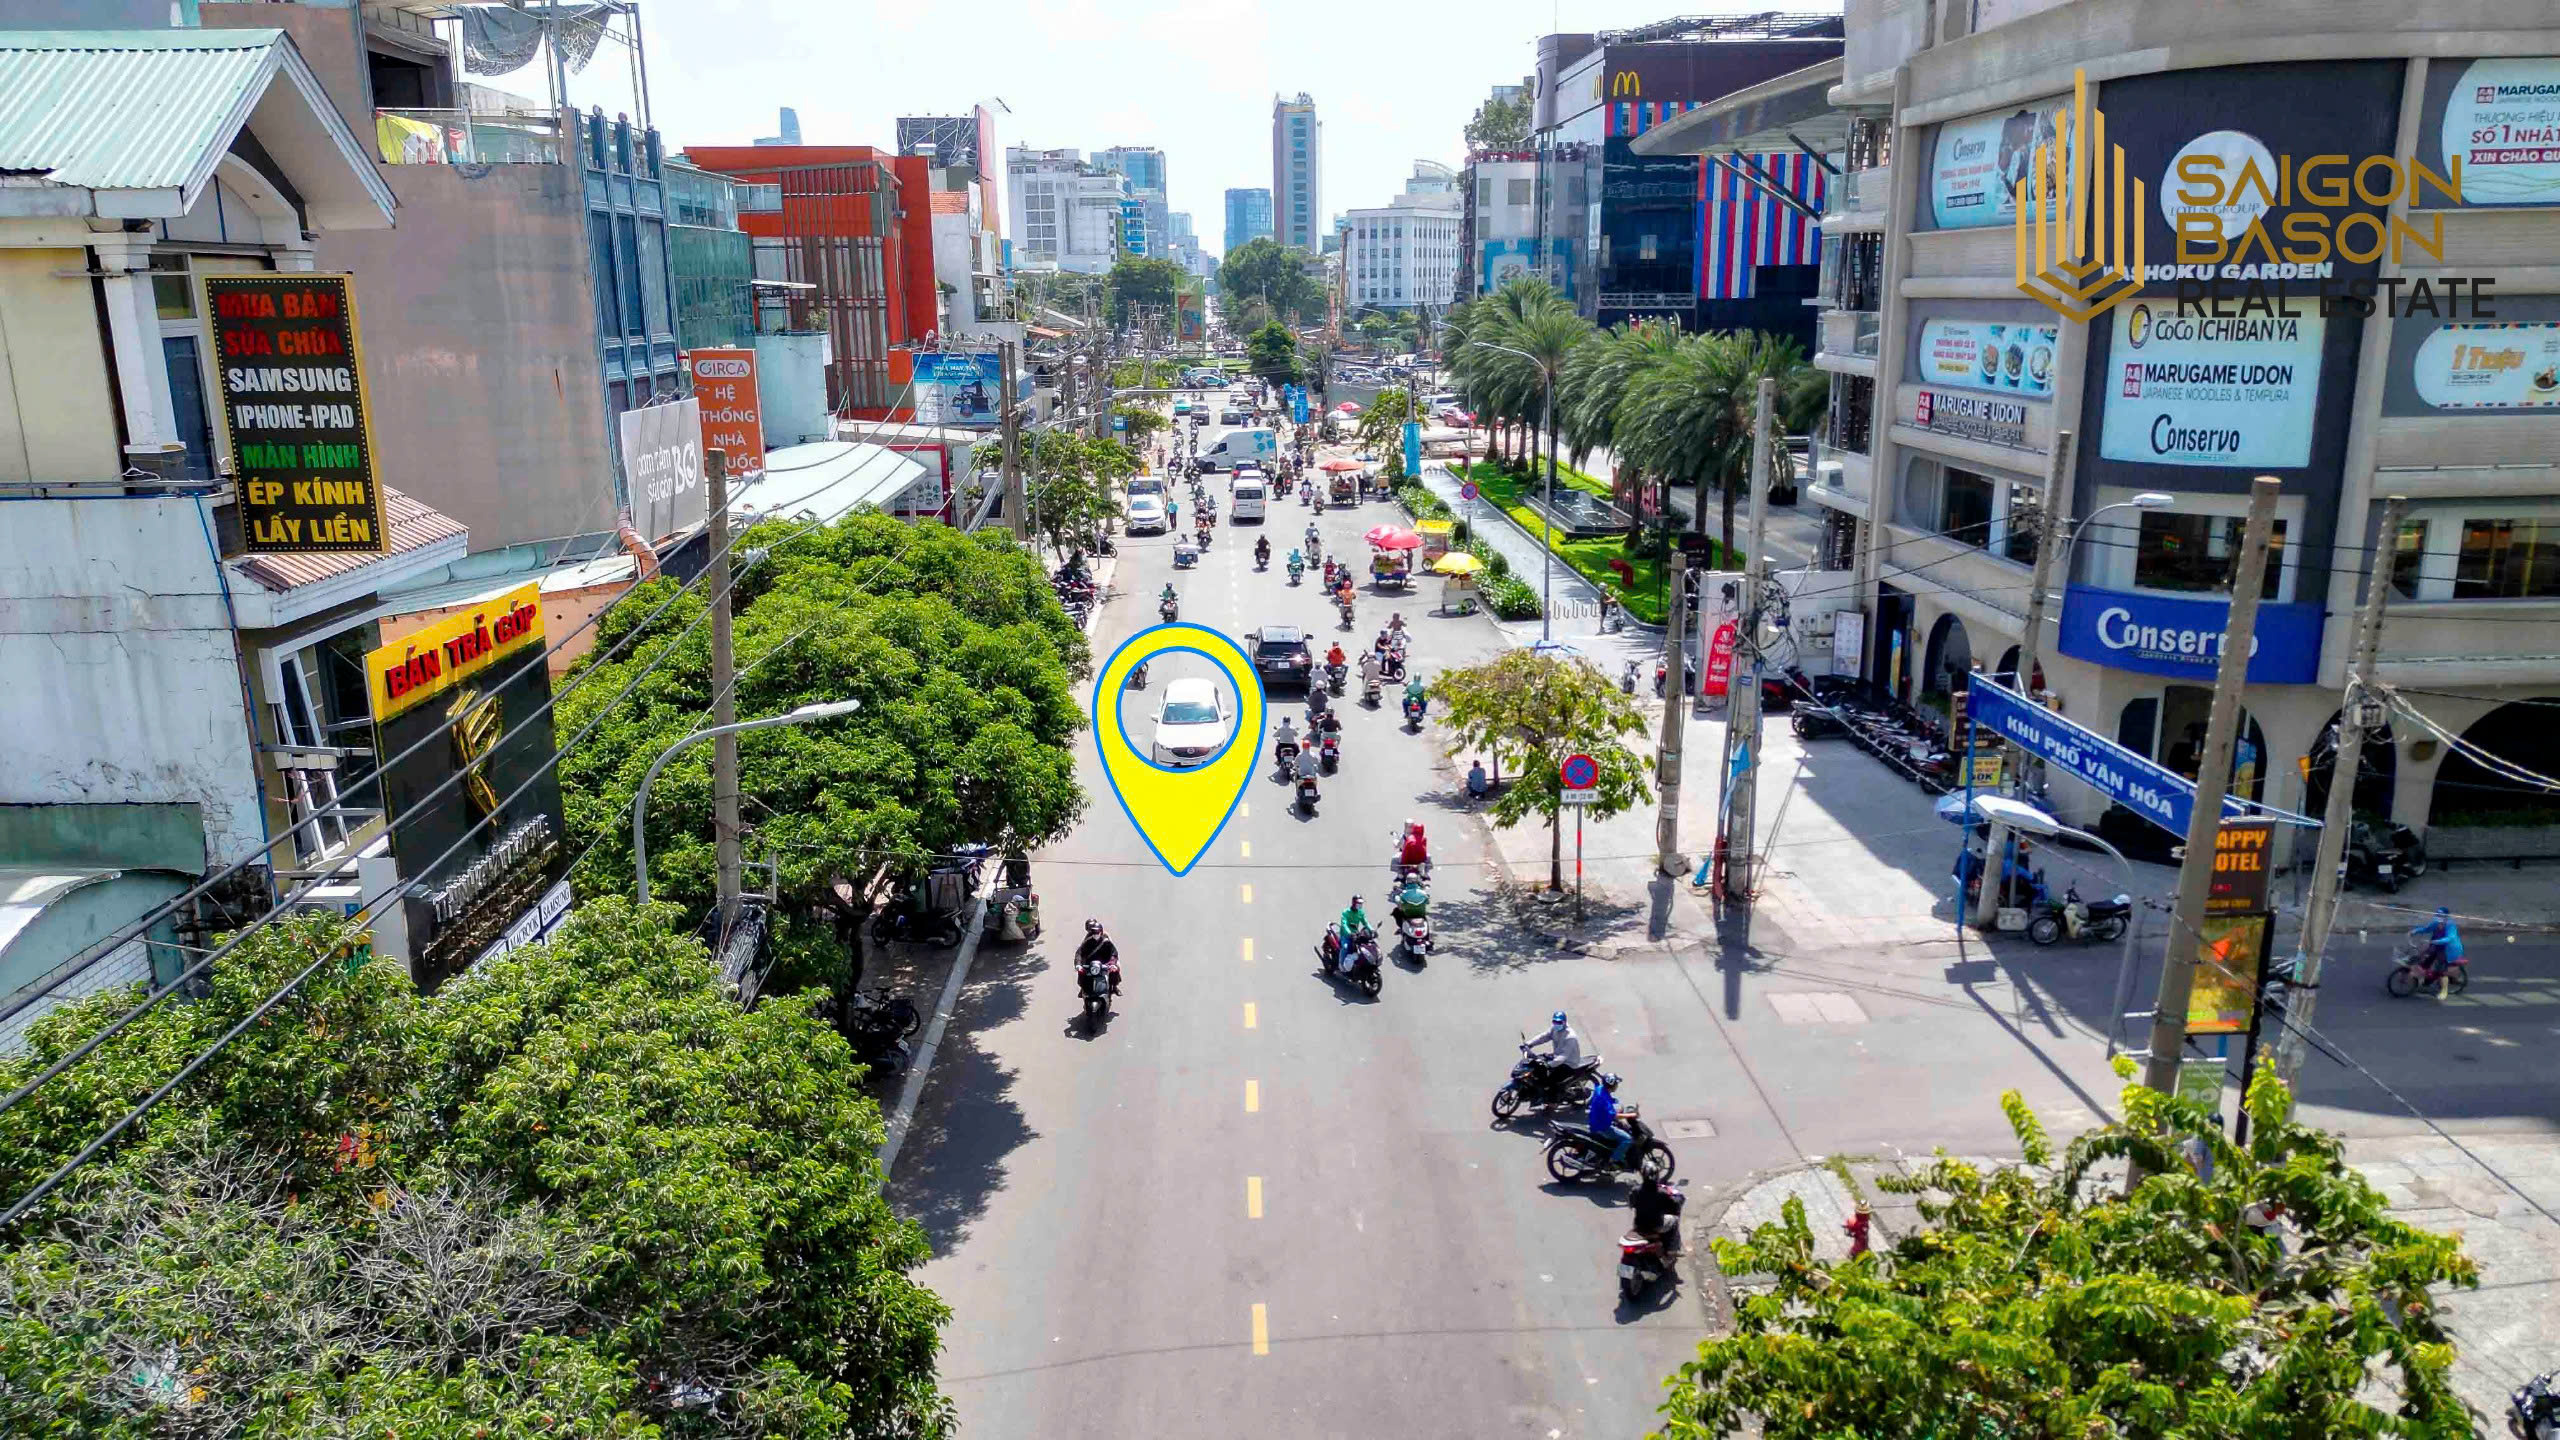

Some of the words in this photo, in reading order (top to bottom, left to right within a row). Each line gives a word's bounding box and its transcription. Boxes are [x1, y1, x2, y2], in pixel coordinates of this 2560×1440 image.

[2472, 124, 2498, 143] SỐ
[2502, 125, 2511, 143] 1
[2473, 152, 2497, 163] XIN
[2500, 149, 2540, 162] CHÀO
[2221, 262, 2333, 280] GARDEN
[217, 291, 277, 319] MUA
[224, 323, 272, 356] SỬA
[277, 325, 344, 356] CHỮA
[228, 368, 352, 392] SAMSUNG
[2145, 364, 2236, 384] MARUGAME
[2241, 365, 2292, 385] UDON
[715, 384, 736, 402] HỆ
[236, 404, 354, 429] IPHONE-IPAD
[701, 405, 755, 423] THỐNG
[1933, 393, 1988, 419] MARUGAME
[1991, 403, 2023, 424] UDON
[713, 431, 746, 447] NHÀ
[2151, 413, 2240, 455] Conservo
[242, 439, 297, 468] MÀN
[303, 440, 360, 469] HÌNH
[248, 477, 284, 505] ÉP
[293, 477, 365, 505] KÍNH
[254, 512, 302, 542] LẤY
[311, 512, 371, 542] LIỀN
[385, 645, 441, 699] BÁN
[443, 613, 493, 668] TRẢ
[494, 600, 537, 644] GÓP
[2007, 716, 2039, 743] KHU
[2044, 736, 2081, 765] PHỐ
[2085, 757, 2124, 791] VĂN
[2129, 782, 2174, 820] HÓA
[2215, 830, 2267, 848] APPY
[2215, 852, 2261, 871] OTEL
